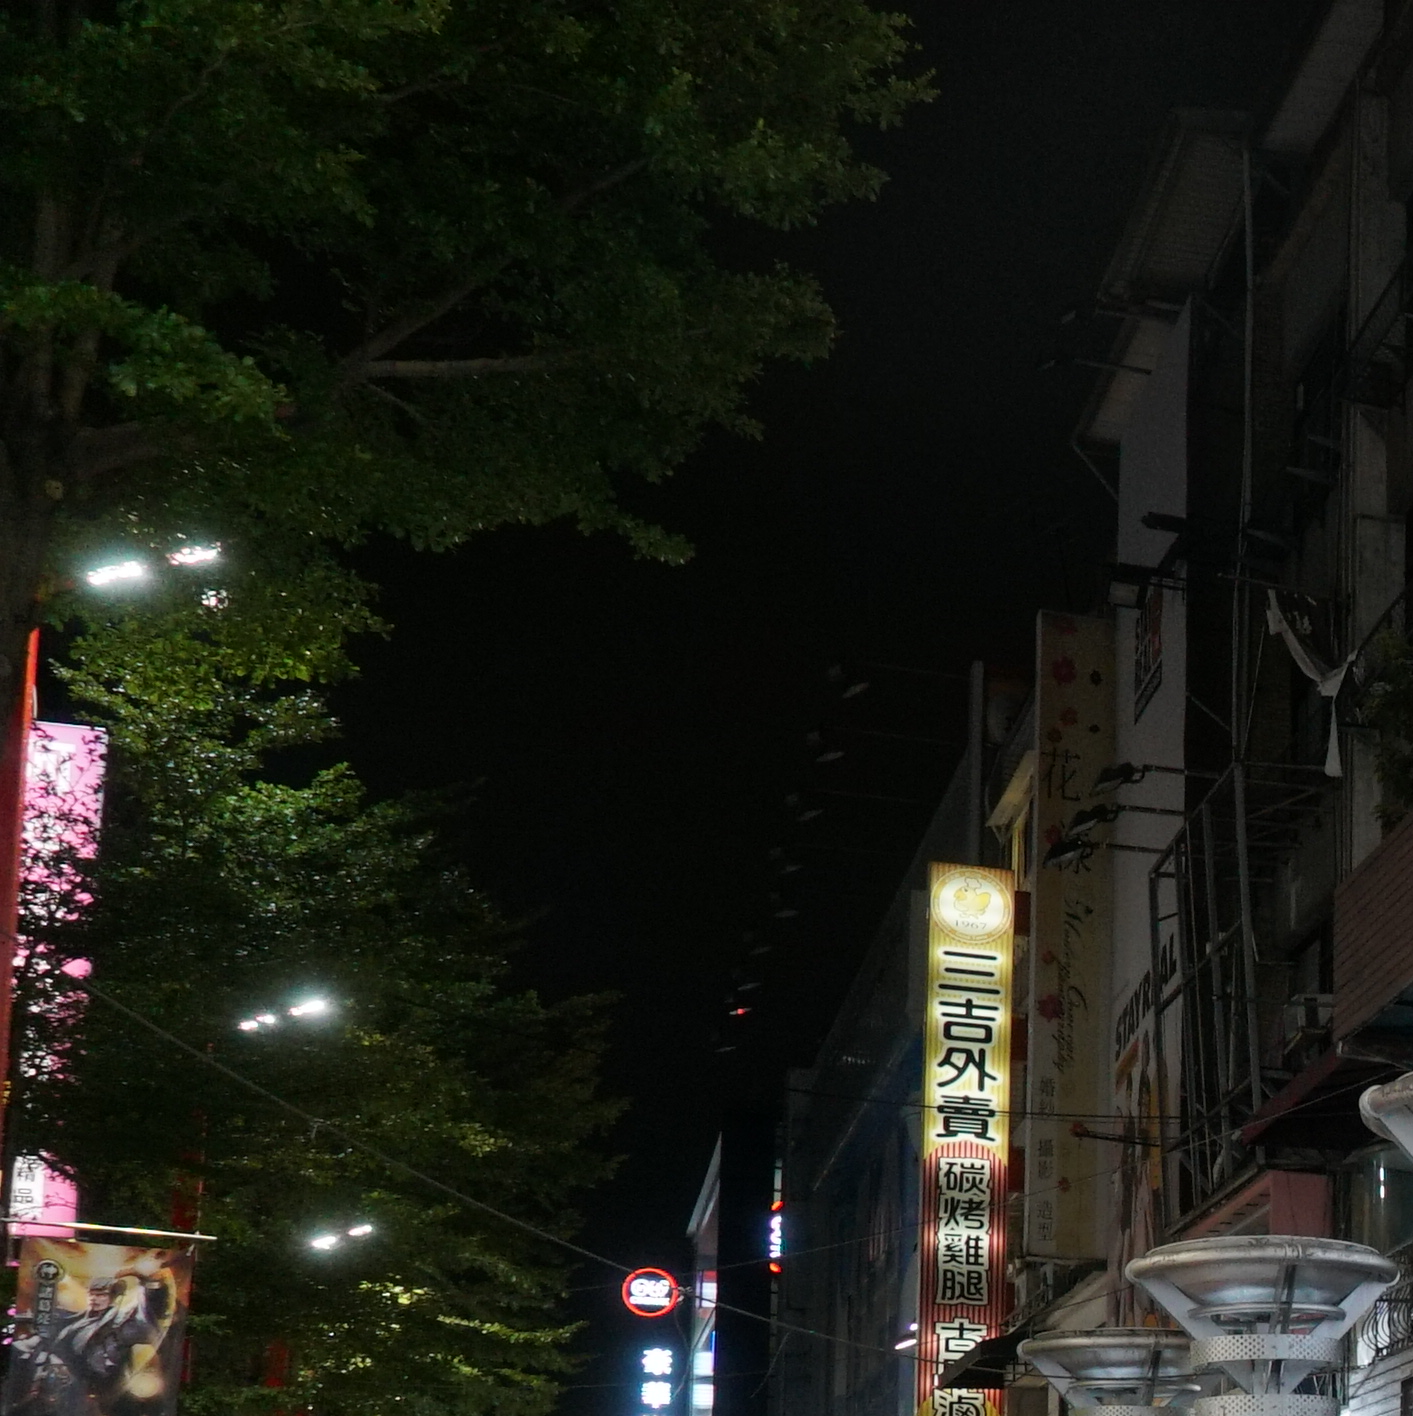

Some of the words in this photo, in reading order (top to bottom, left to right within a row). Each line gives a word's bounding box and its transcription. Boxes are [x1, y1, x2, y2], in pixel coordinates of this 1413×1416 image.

[953, 920, 988, 931] 1967
[937, 950, 1001, 1142] 三吉外賣
[1115, 932, 1178, 1062] STAYRAL
[940, 1160, 988, 1303] 碳烤雞腿
